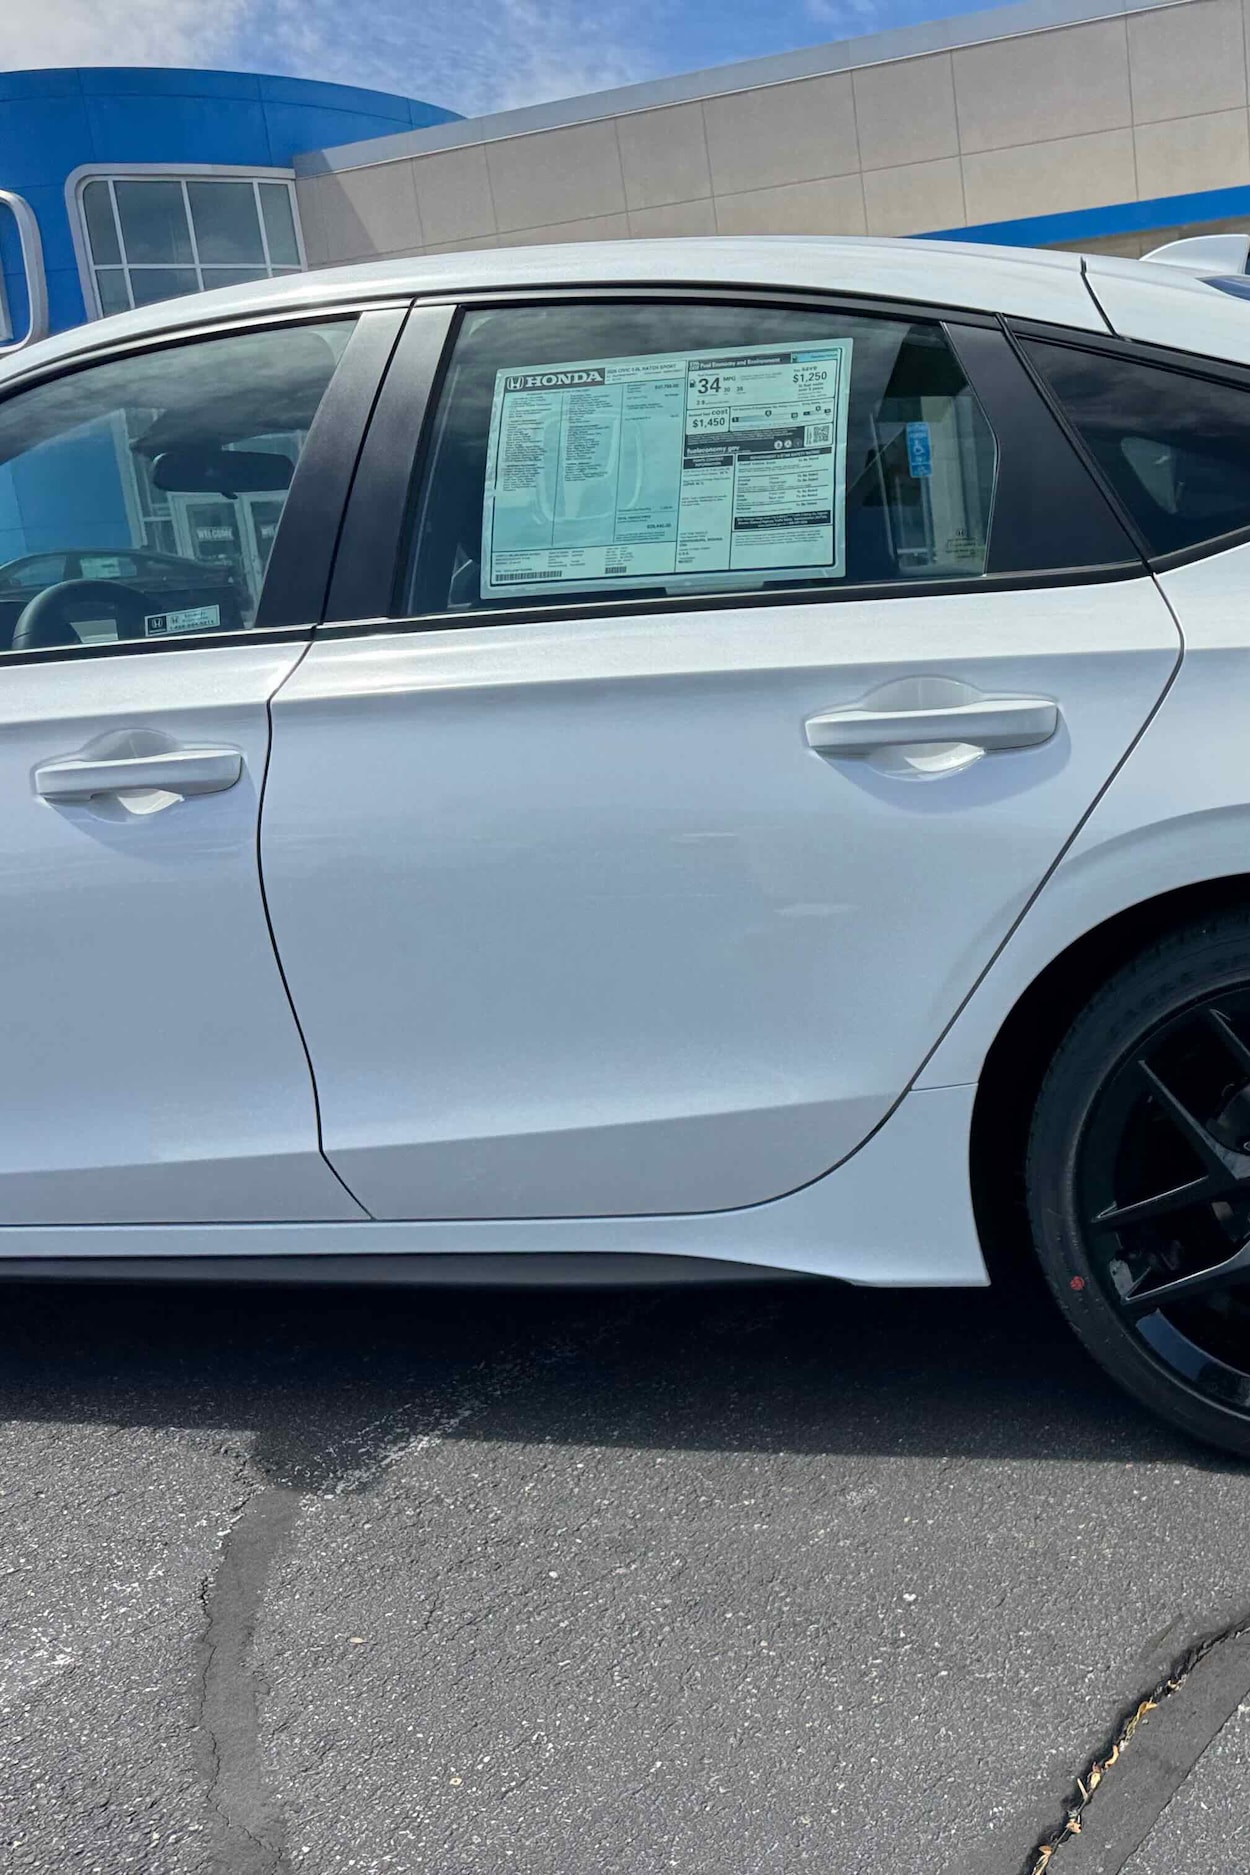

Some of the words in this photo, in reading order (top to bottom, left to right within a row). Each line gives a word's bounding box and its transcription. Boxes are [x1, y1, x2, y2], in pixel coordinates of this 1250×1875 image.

[526, 371, 603, 387] HONDA
[792, 370, 828, 384] $1,250
[697, 377, 721, 394] 34
[711, 408, 728, 416] cost
[692, 416, 726, 429] $1,450
